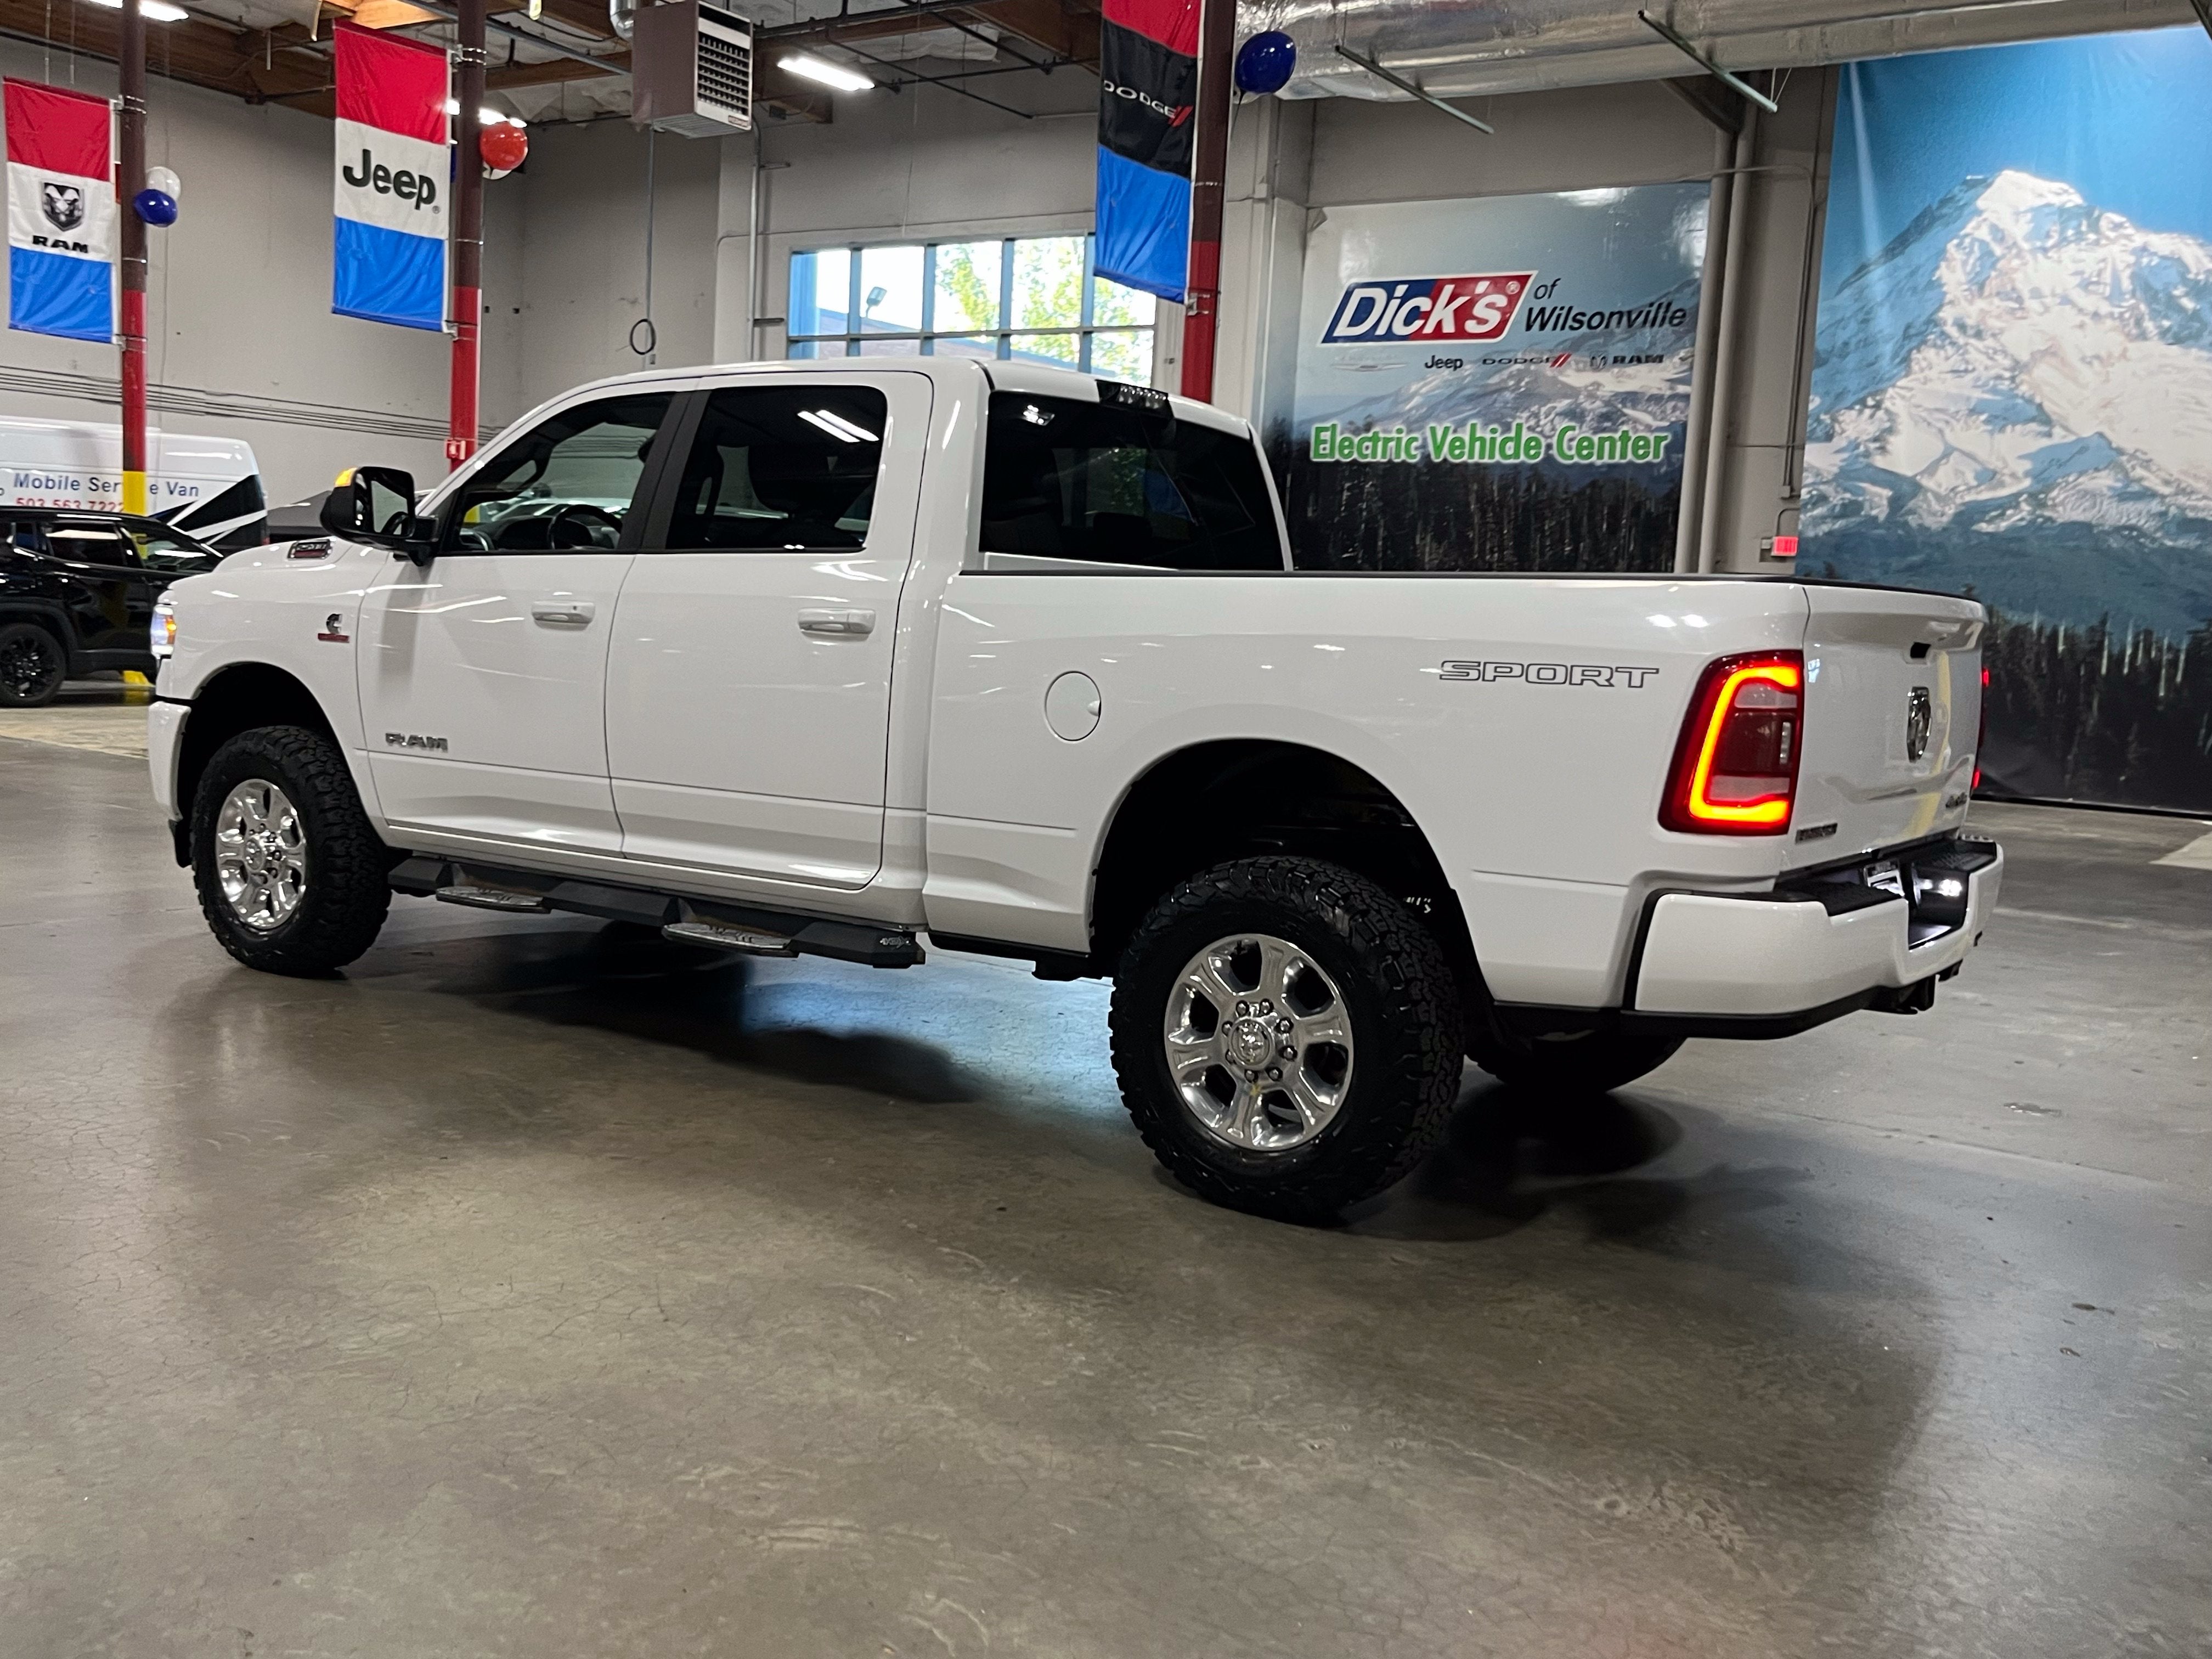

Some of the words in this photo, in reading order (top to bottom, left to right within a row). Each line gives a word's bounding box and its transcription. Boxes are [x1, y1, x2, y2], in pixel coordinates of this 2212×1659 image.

[1104, 80, 1176, 119] DODGE
[343, 149, 436, 210] Jeep
[32, 235, 88, 253] RAM
[1534, 278, 1561, 300] of
[1333, 281, 1508, 337] Dick's
[1525, 302, 1686, 331] Wilsonville
[1425, 356, 1463, 371] Jeep
[1613, 354, 1664, 363] RAM
[1314, 424, 1419, 459] Electric
[1430, 424, 1542, 460] Vehicle
[1556, 426, 1668, 460] Center
[14, 473, 81, 490] Mobile
[88, 477, 158, 494] Sere
[167, 481, 199, 496] Van
[1440, 661, 1660, 688] SPORT
[385, 733, 448, 752] RAM
